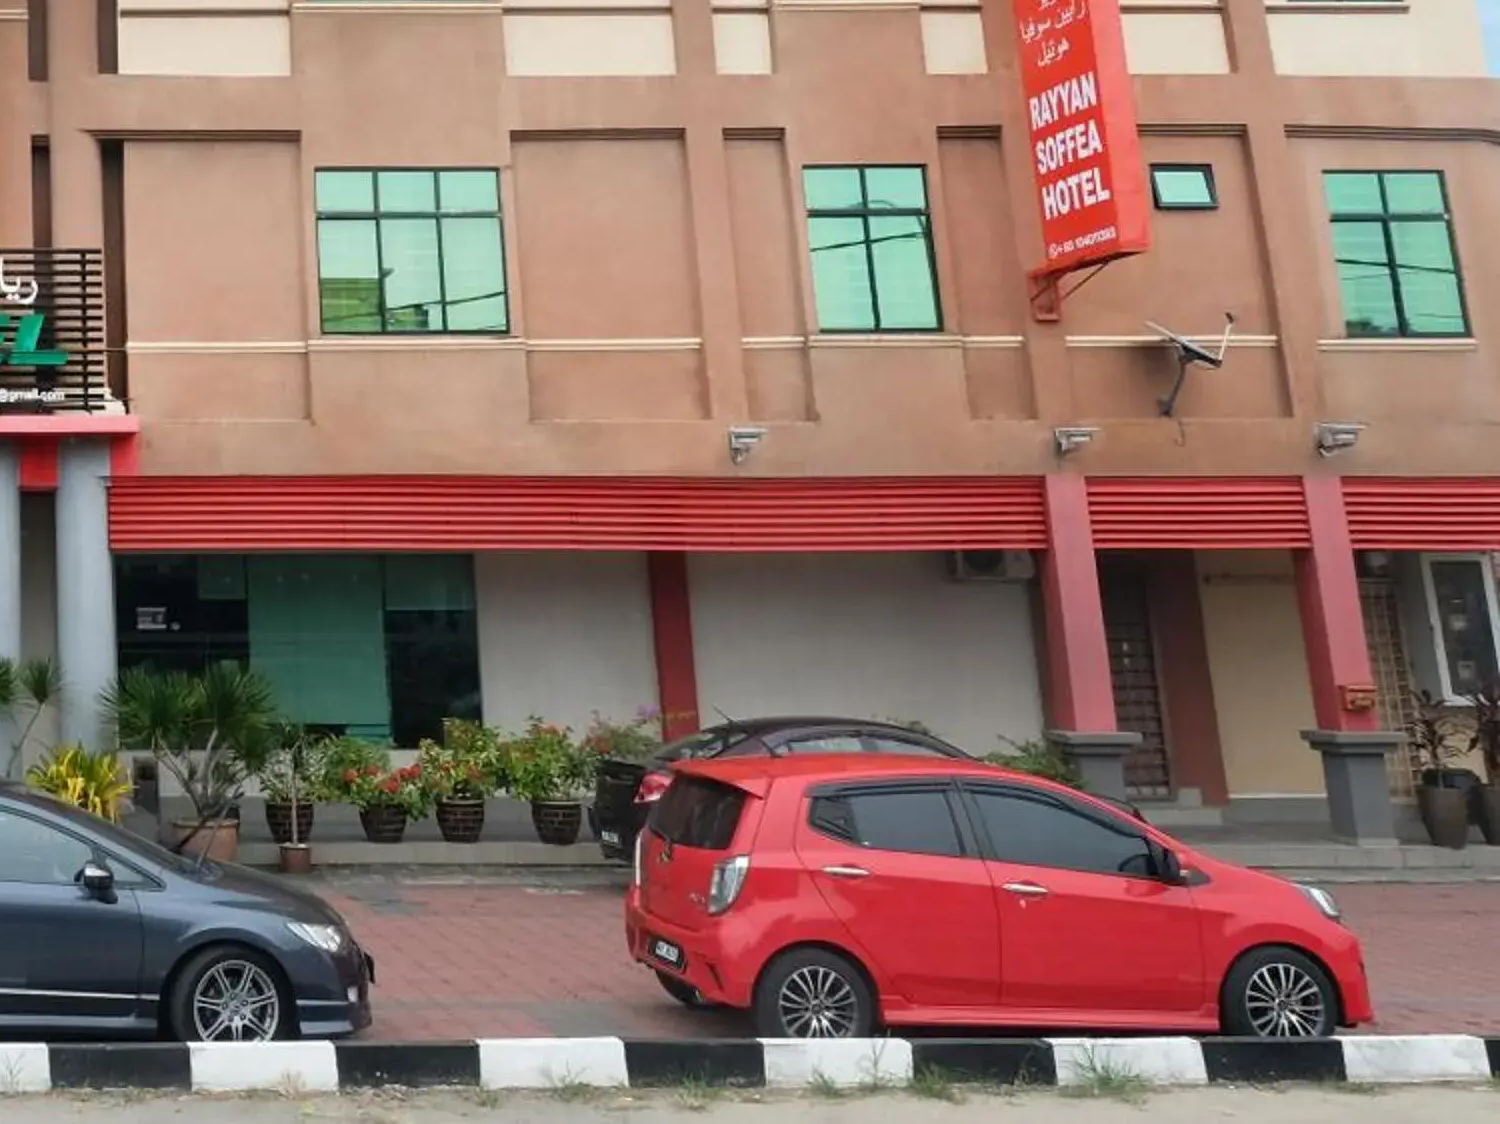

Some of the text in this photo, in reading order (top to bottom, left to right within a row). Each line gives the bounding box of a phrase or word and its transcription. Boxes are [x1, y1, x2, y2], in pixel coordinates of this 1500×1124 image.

[1029, 71, 1098, 131] RAYYAN
[1035, 119, 1103, 175] SOFFEA
[1041, 167, 1111, 221] HOTEL
